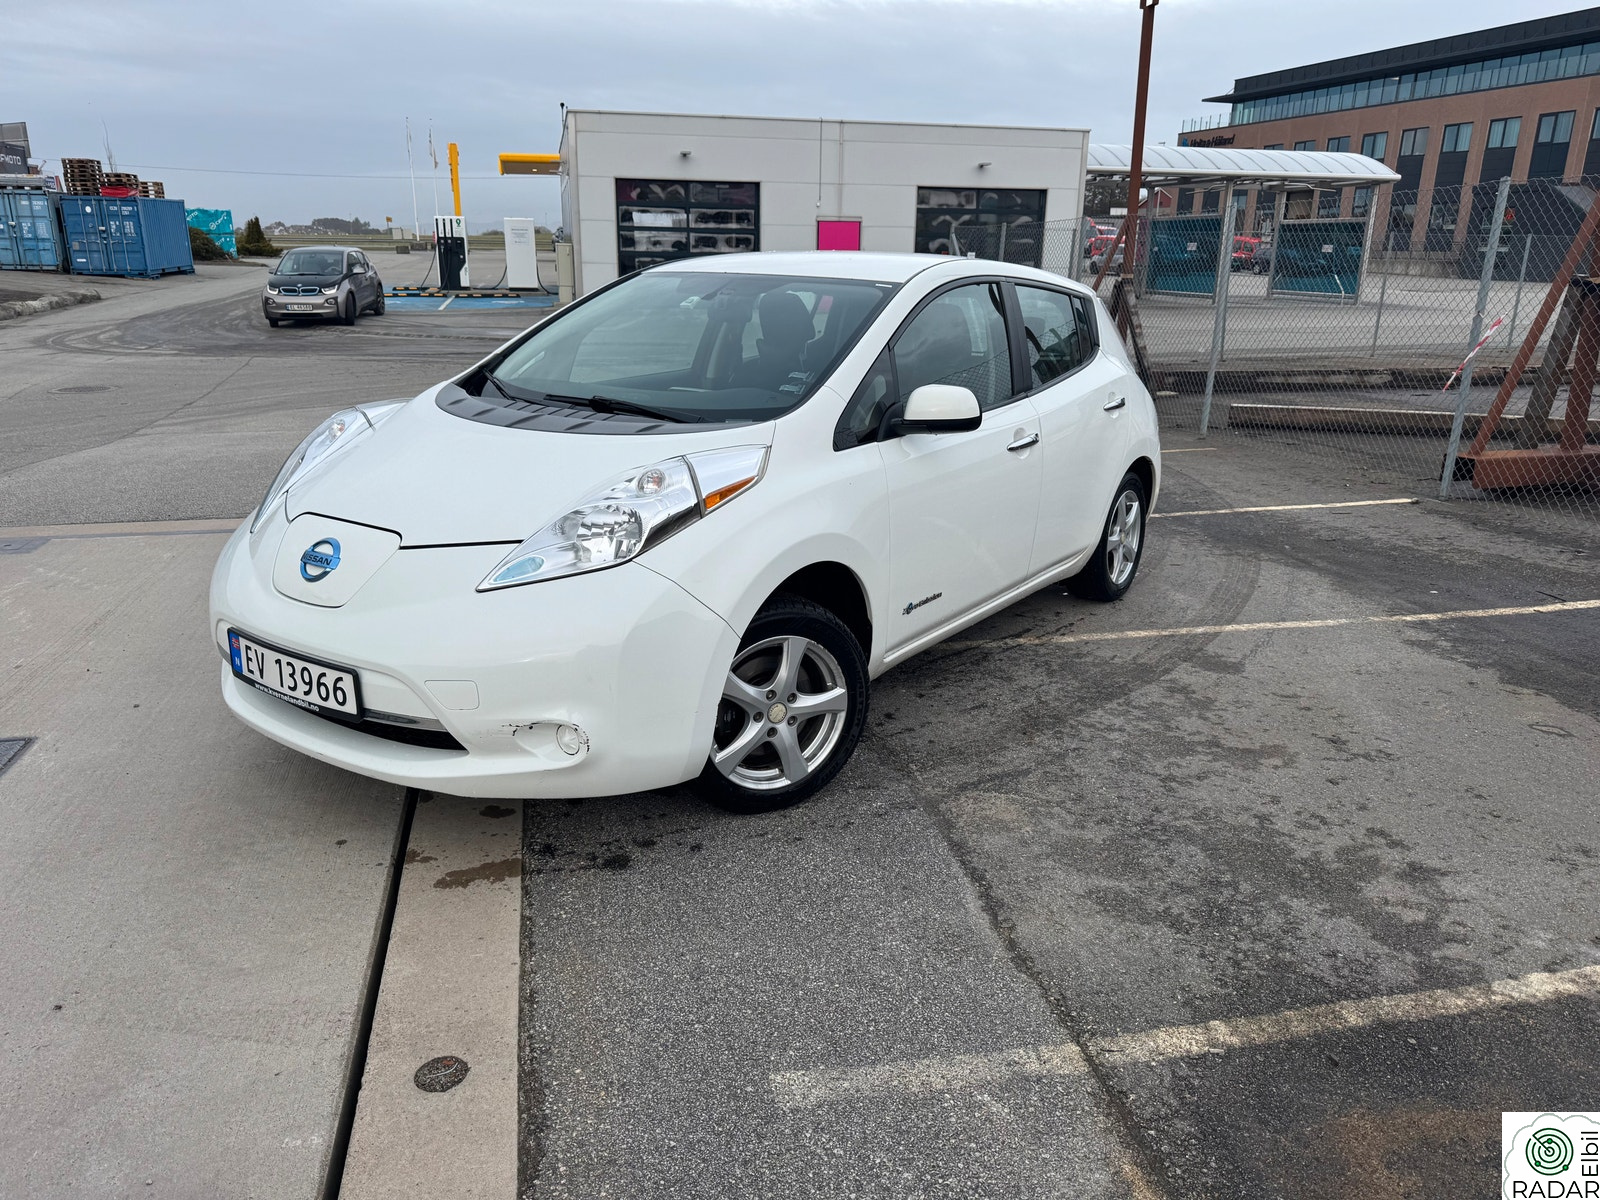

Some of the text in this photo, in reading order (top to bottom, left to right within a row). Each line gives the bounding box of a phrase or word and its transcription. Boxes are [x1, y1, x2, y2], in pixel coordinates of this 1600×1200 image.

[303, 553, 332, 566] NISSAN
[244, 644, 347, 706] EV 13966
[254, 682, 320, 712] www.kvernelandbil.no
